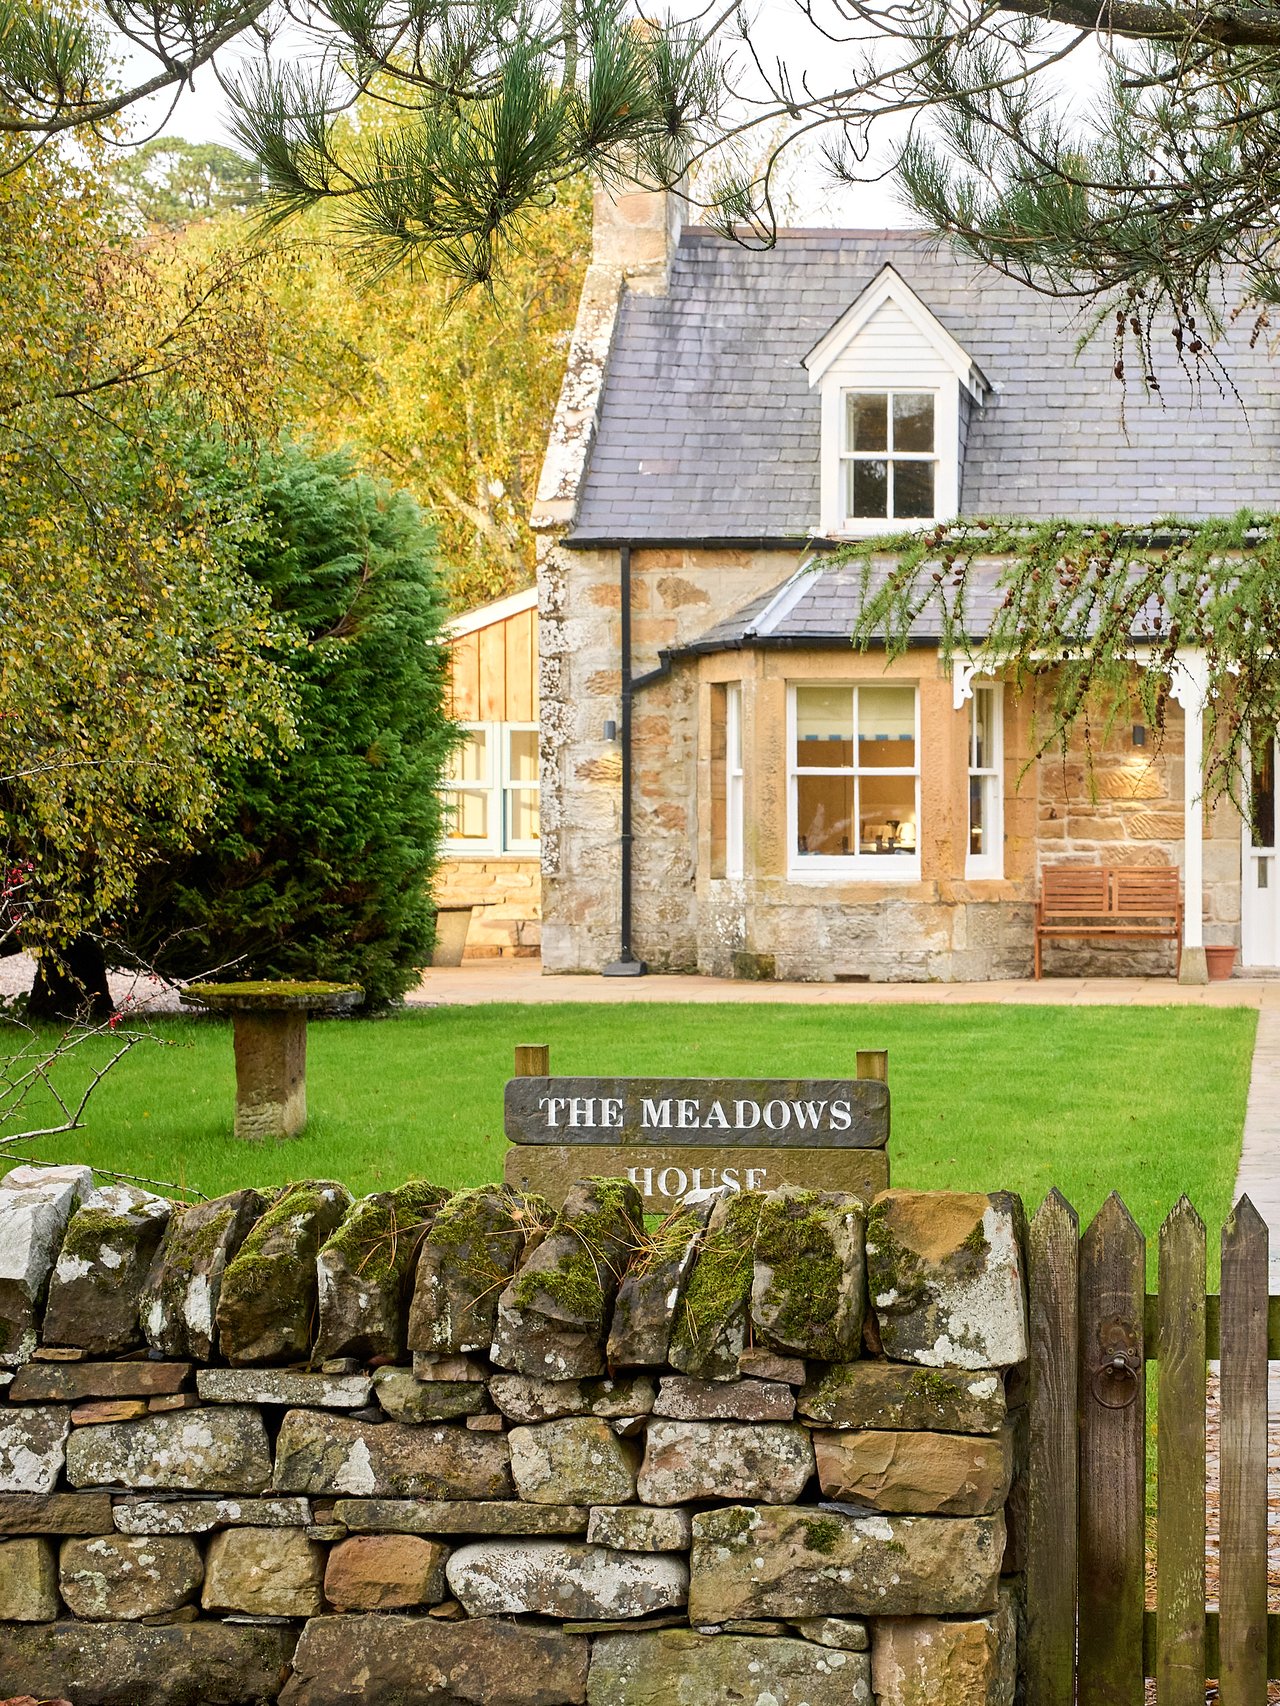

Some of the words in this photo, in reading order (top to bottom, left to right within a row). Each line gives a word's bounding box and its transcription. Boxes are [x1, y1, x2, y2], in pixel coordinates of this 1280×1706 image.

[539, 1097, 624, 1128] THE
[640, 1098, 852, 1130] MEADOWS
[625, 1167, 767, 1197] HOUSE
